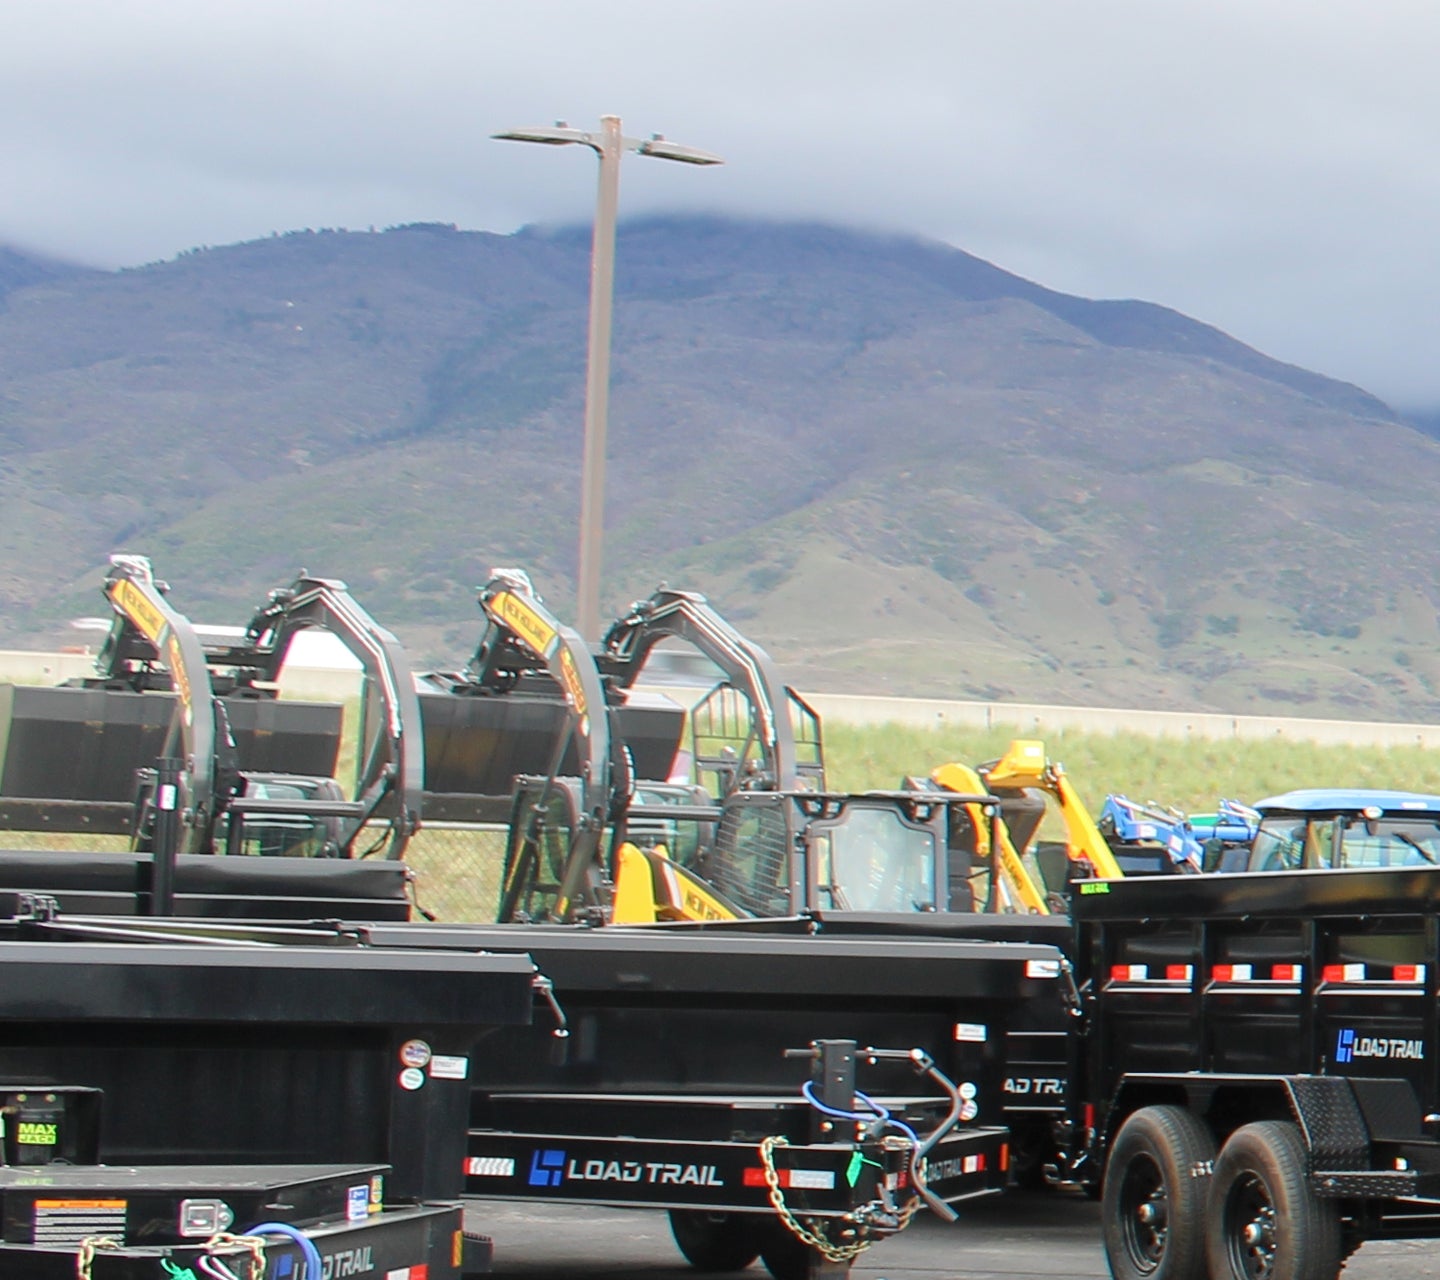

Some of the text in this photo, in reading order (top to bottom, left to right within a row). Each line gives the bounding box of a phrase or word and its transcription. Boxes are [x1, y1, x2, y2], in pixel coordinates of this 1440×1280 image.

[1353, 1037, 1424, 1059] LOAD TRAIL
[18, 1123, 57, 1135] MAX
[19, 1135, 55, 1144] JACK
[567, 1159, 724, 1186] LOAD TRAIL
[335, 1245, 375, 1279] TRAIL
